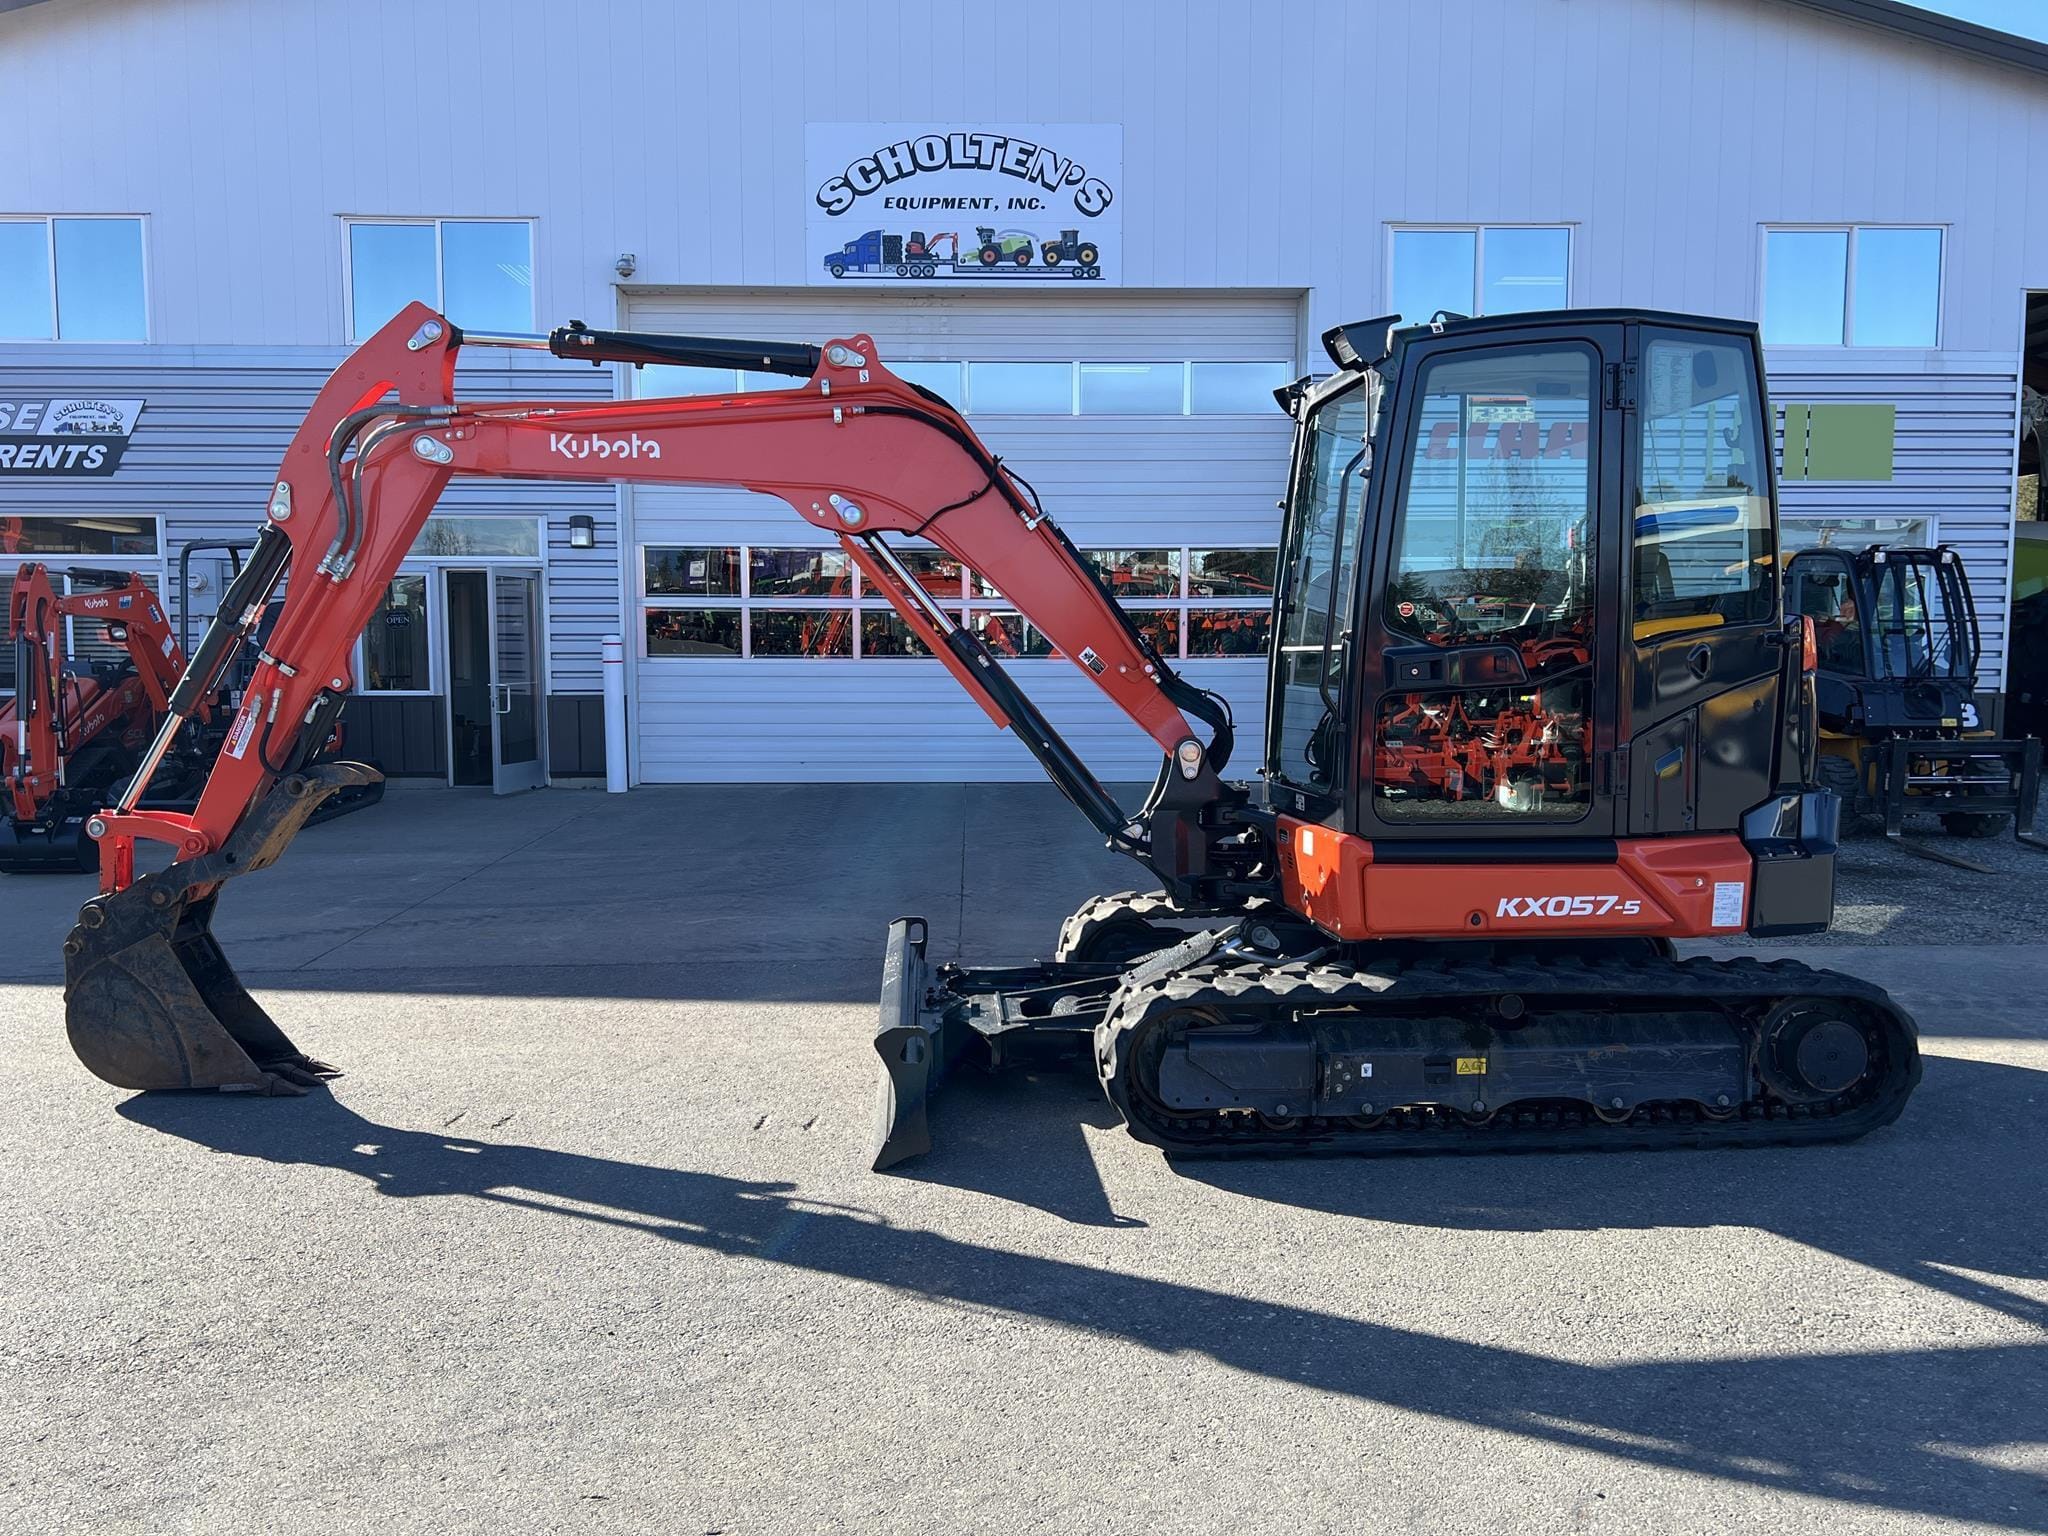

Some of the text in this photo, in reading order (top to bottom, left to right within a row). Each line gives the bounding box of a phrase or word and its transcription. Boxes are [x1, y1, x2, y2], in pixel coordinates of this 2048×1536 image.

[816, 133, 1113, 217] SCHOLTEN'S
[883, 197, 1046, 211] EQUIPMENT, INC.
[53, 400, 124, 421] SCHOLTEN'S
[550, 433, 661, 459] Kubota
[84, 598, 109, 608] Kubota
[386, 616, 410, 625] OPEN
[232, 714, 247, 741] DANGER
